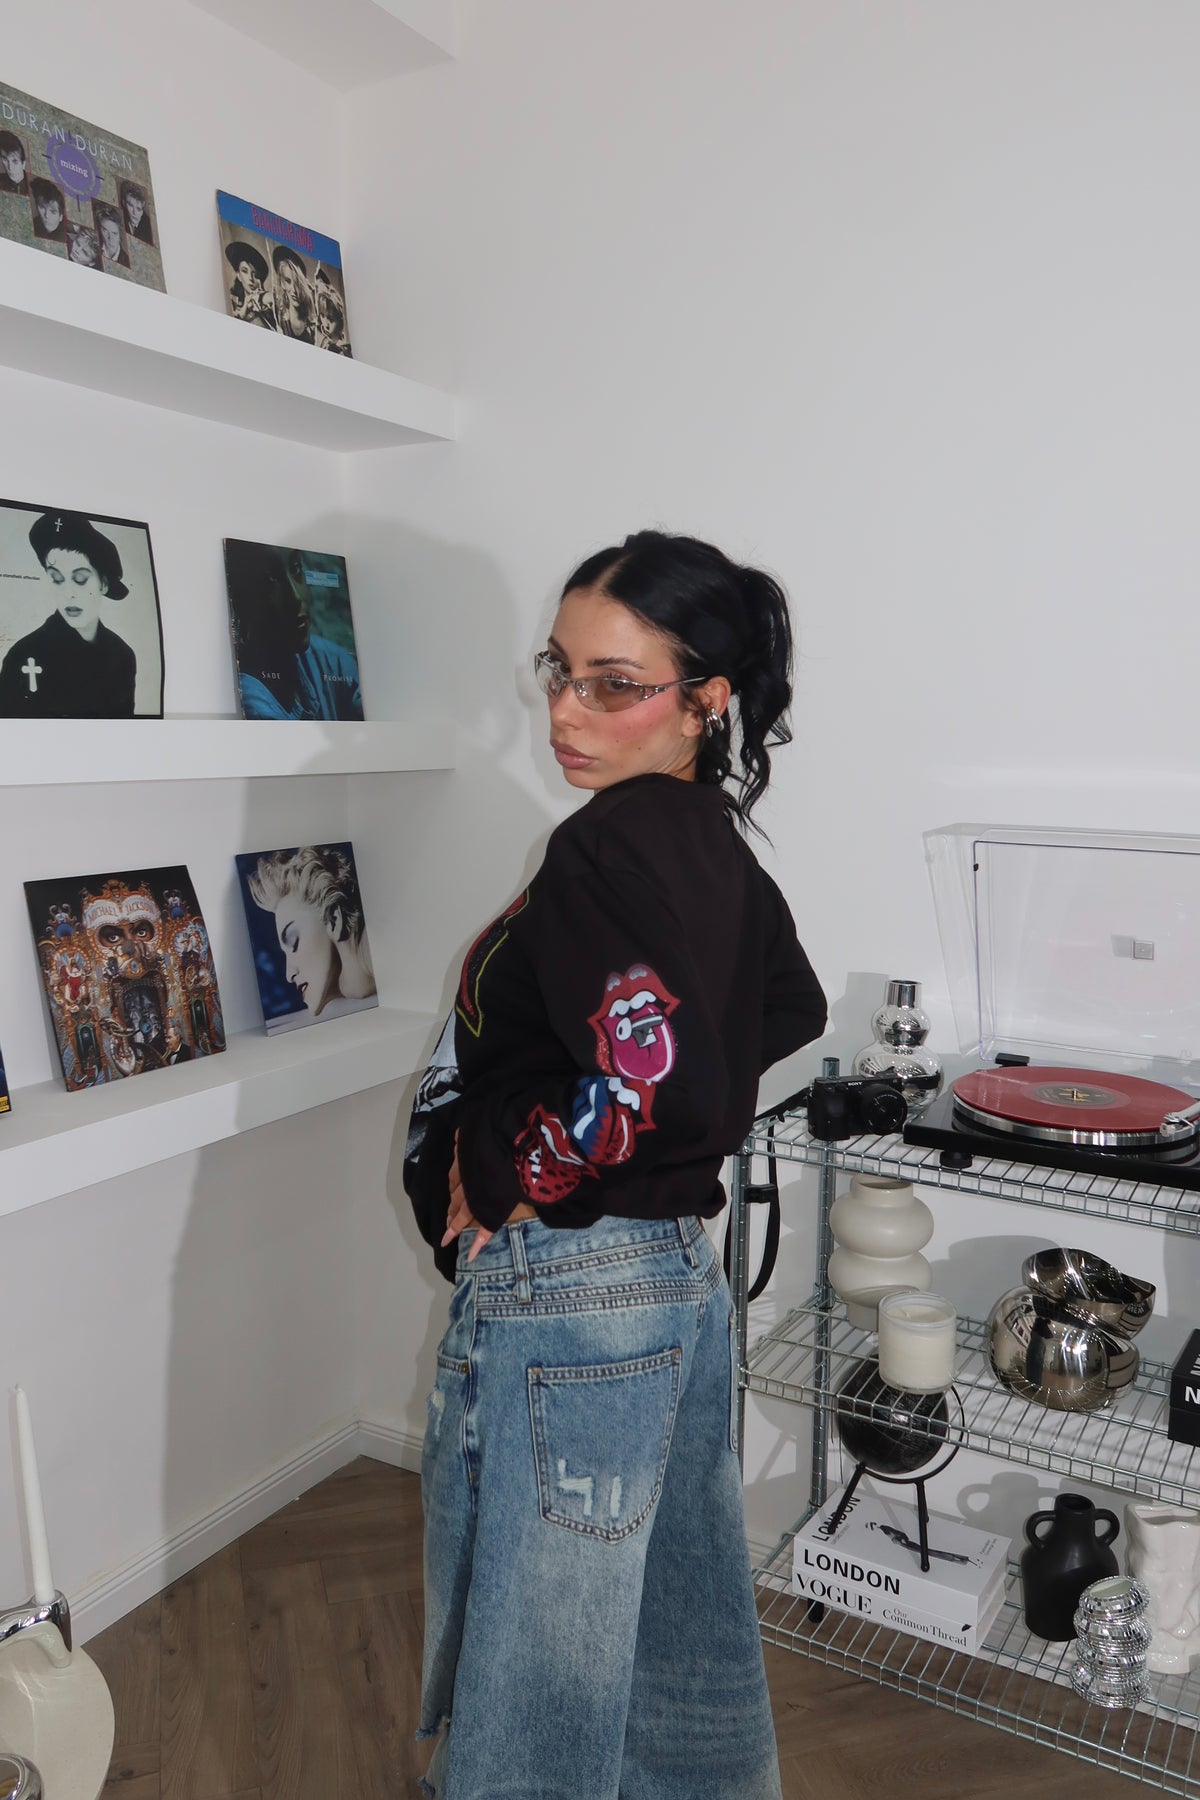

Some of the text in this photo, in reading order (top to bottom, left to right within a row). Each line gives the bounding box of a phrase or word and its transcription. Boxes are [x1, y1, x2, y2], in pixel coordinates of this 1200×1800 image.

[1, 102, 65, 143] DURAN
[75, 134, 133, 171] DURAN
[60, 159, 88, 178] mixing
[804, 1549, 900, 1595] LONDON
[796, 1573, 872, 1615] VOGUE
[893, 1607, 907, 1618] Our
[883, 1609, 967, 1647] Common Thread
